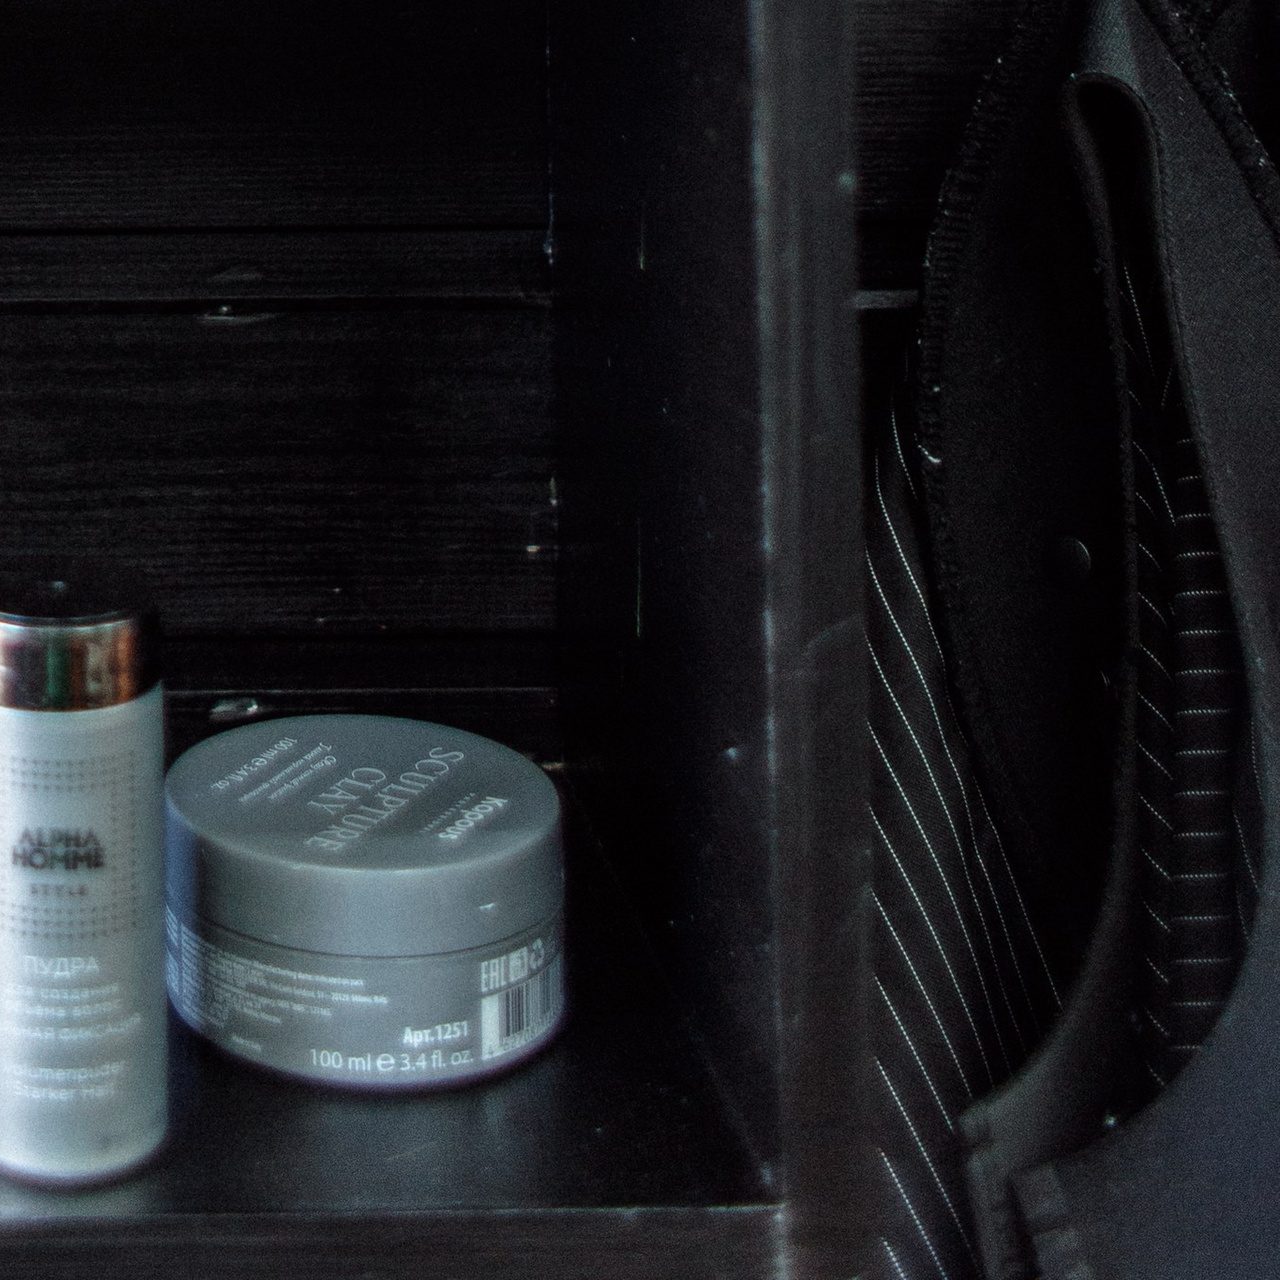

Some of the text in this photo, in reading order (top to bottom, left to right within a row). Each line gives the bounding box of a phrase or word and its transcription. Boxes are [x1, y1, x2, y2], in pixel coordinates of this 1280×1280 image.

[257, 748, 282, 760] ml
[272, 736, 300, 751] 100
[302, 745, 468, 853] SCULPTURE
[305, 765, 389, 816] CLAY
[24, 955, 100, 979] ПУДРА
[310, 1049, 343, 1069] 100
[348, 1053, 371, 1072] ml
[400, 1053, 427, 1071] 3.4
[431, 1049, 446, 1069] fl.
[450, 1050, 474, 1065] oz.
